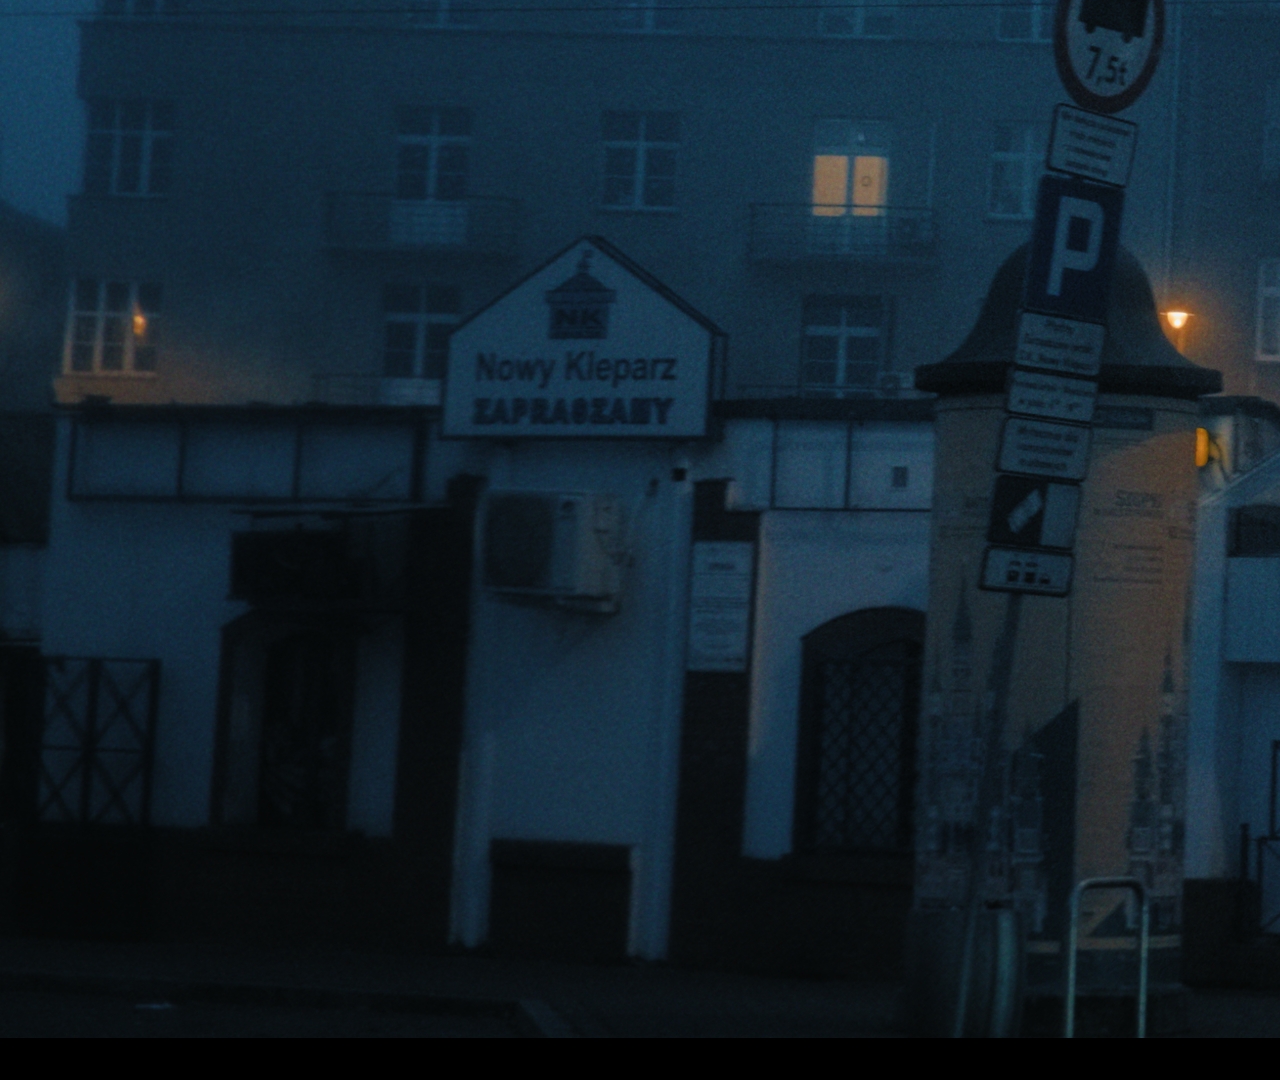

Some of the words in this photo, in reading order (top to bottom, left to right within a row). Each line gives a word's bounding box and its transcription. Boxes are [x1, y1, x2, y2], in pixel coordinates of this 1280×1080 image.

[1085, 45, 1128, 86] 7,5t
[1046, 195, 1104, 297] P
[475, 352, 555, 389] Nowy
[564, 351, 678, 389] Kleparz
[472, 397, 675, 426] ZAPRASZAMY
